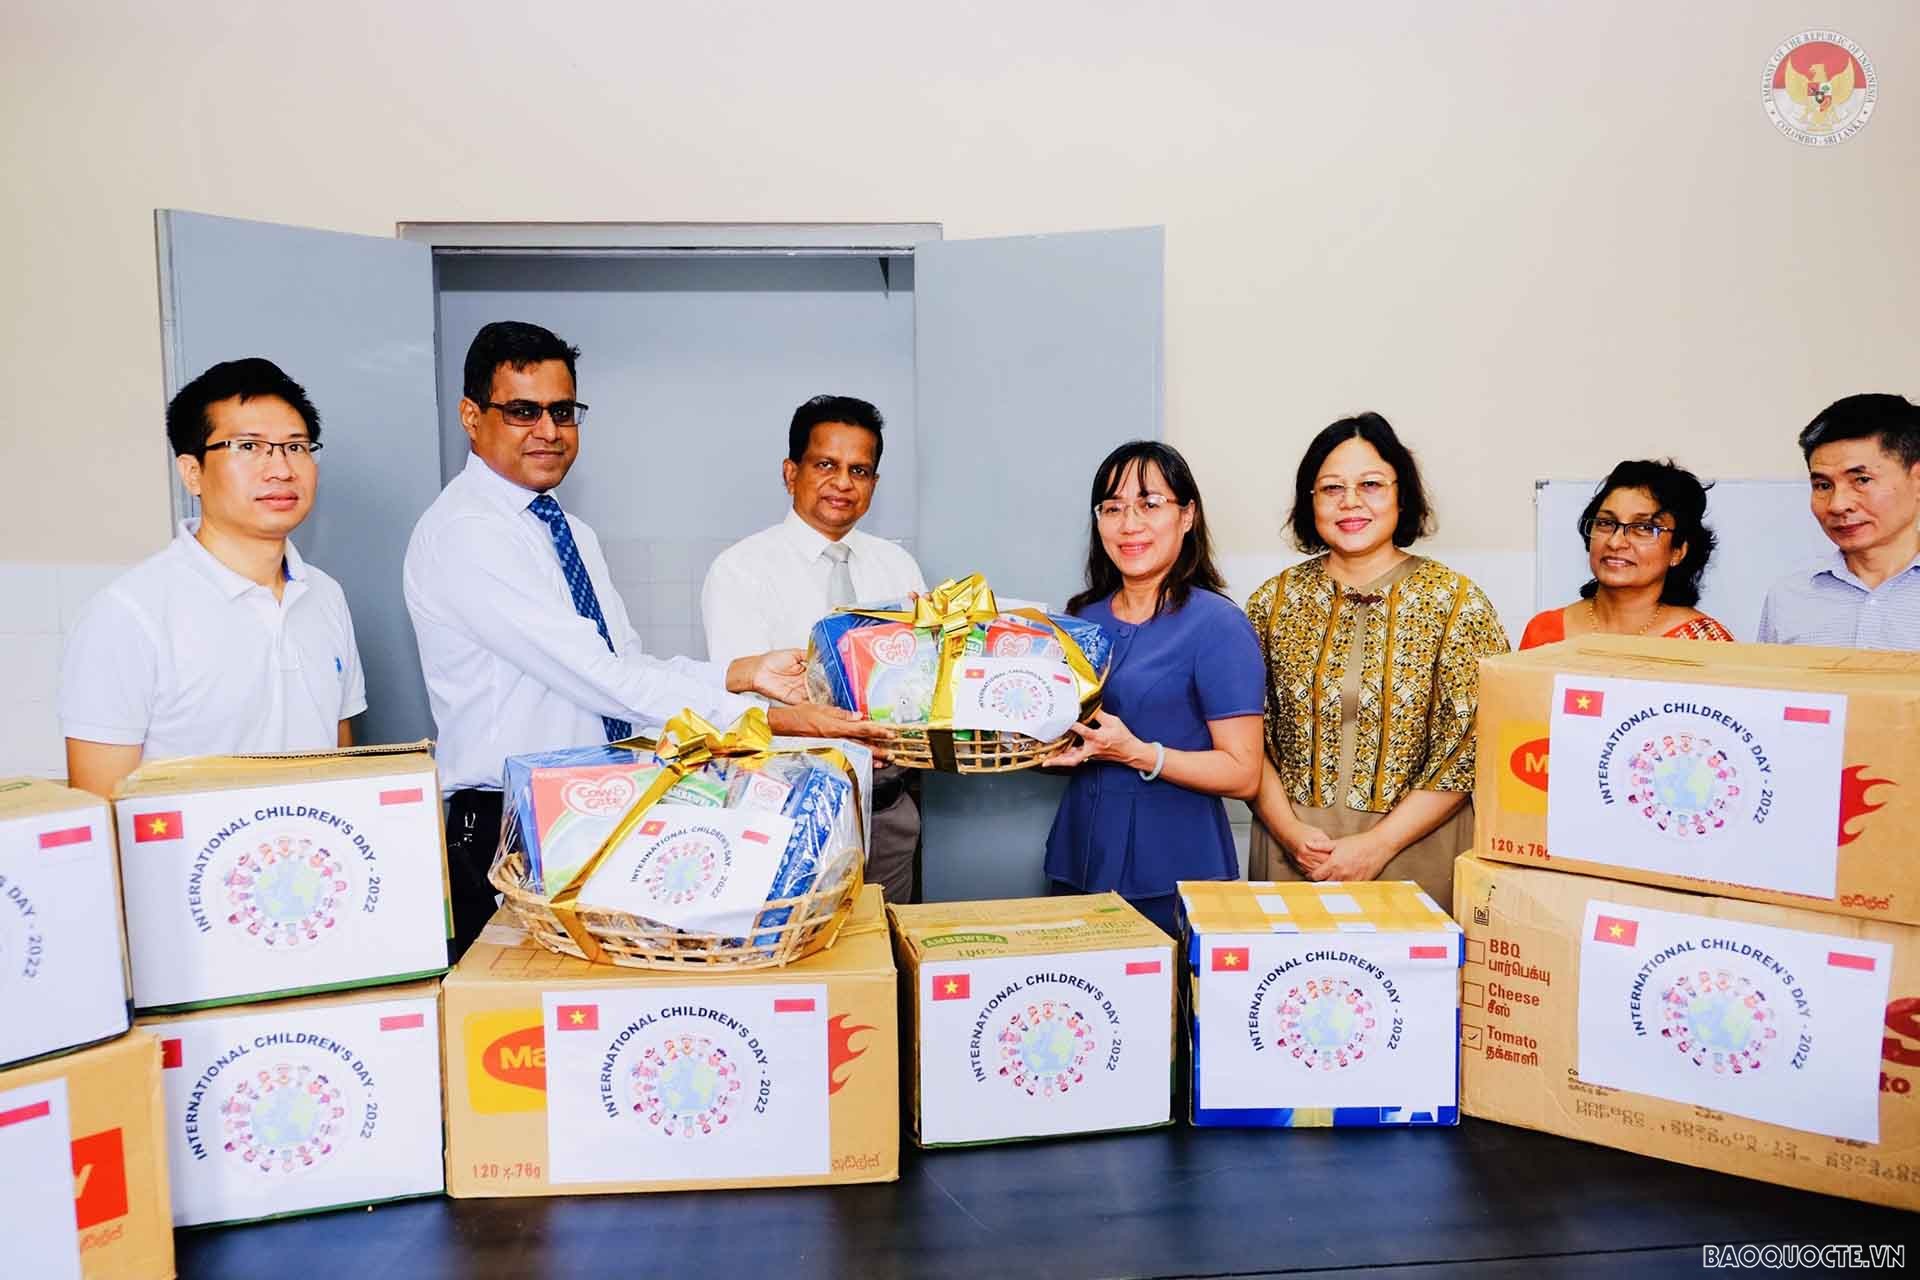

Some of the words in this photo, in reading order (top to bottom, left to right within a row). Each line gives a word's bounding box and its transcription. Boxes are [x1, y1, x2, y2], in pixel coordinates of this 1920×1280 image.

[1663, 703, 1753, 743] CHILDREN'S
[1598, 706, 1659, 805] INTERNATIONAL
[1751, 745, 1772, 774] DAY
[254, 805, 354, 835] CHILDREN'S
[1753, 789, 1773, 824] 2022
[352, 834, 377, 864] DAY
[1491, 837, 1513, 853] 120
[188, 817, 250, 933] INTERNATIONAL
[363, 876, 381, 913] 2022
[7, 887, 36, 917] DAY
[24, 935, 42, 979] 2022
[1490, 939, 1521, 959] BBQ
[1305, 951, 1385, 980] CHILDREN'S
[1700, 938, 1795, 986] CHILDREN'S
[1025, 972, 1104, 1001] CHILDREN'S
[1382, 979, 1401, 1004] DAY
[1488, 982, 1540, 1007] Cheese
[1630, 940, 1696, 1037] INTERNATIONAL
[1791, 987, 1812, 1018] DAY
[1102, 1000, 1120, 1026] DAY
[1248, 957, 1302, 1052] INTERNATIONAL
[660, 1006, 750, 1039] CHILDREN'S
[970, 981, 1023, 1083] INTERNATIONAL
[1387, 1017, 1403, 1050] 2022
[1487, 1024, 1538, 1049] Tomato
[254, 1032, 353, 1062] CHILDREN'S
[747, 1038, 769, 1066] DAY
[1105, 1038, 1122, 1072] 2022
[1791, 1033, 1812, 1070] 2022
[351, 1060, 375, 1089] DAY
[600, 1013, 657, 1119] INTERNATIONAL
[185, 1044, 250, 1161] INTERNATIONAL
[753, 1079, 771, 1114] 2022
[360, 1102, 378, 1140] 2022
[473, 1163, 498, 1178] 120
